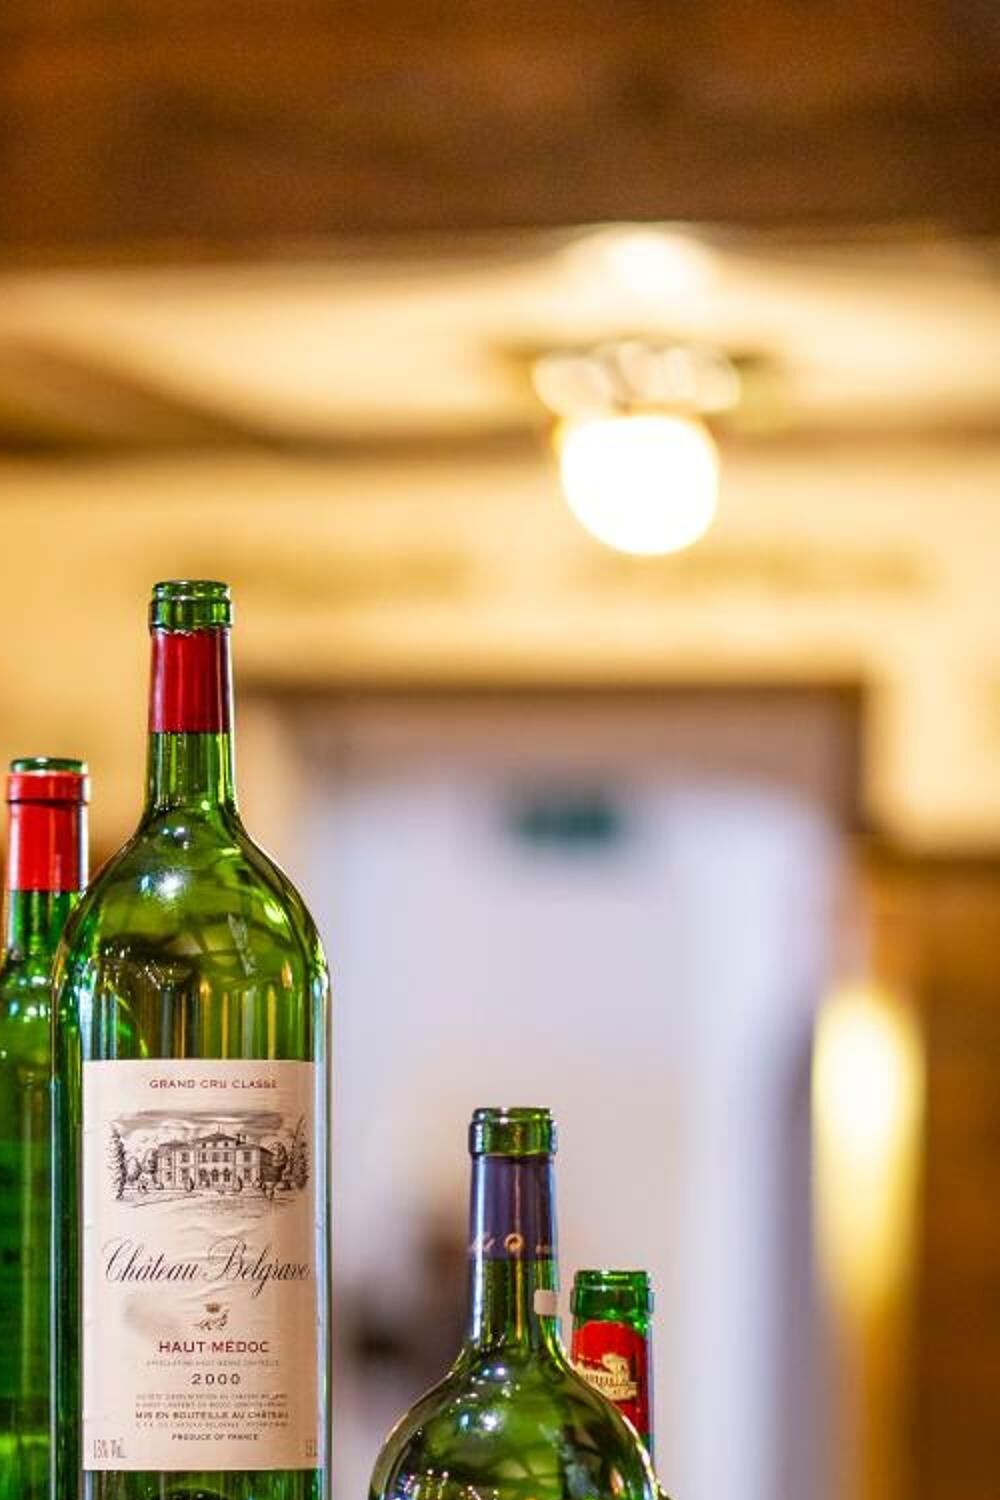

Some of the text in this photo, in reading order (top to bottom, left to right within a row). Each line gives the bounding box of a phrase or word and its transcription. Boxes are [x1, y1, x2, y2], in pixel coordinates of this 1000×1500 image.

[149, 1079, 195, 1089] GRAND
[201, 1079, 227, 1089] CRU
[204, 1236, 311, 1297] Belgrave
[191, 1373, 241, 1385] 2000
